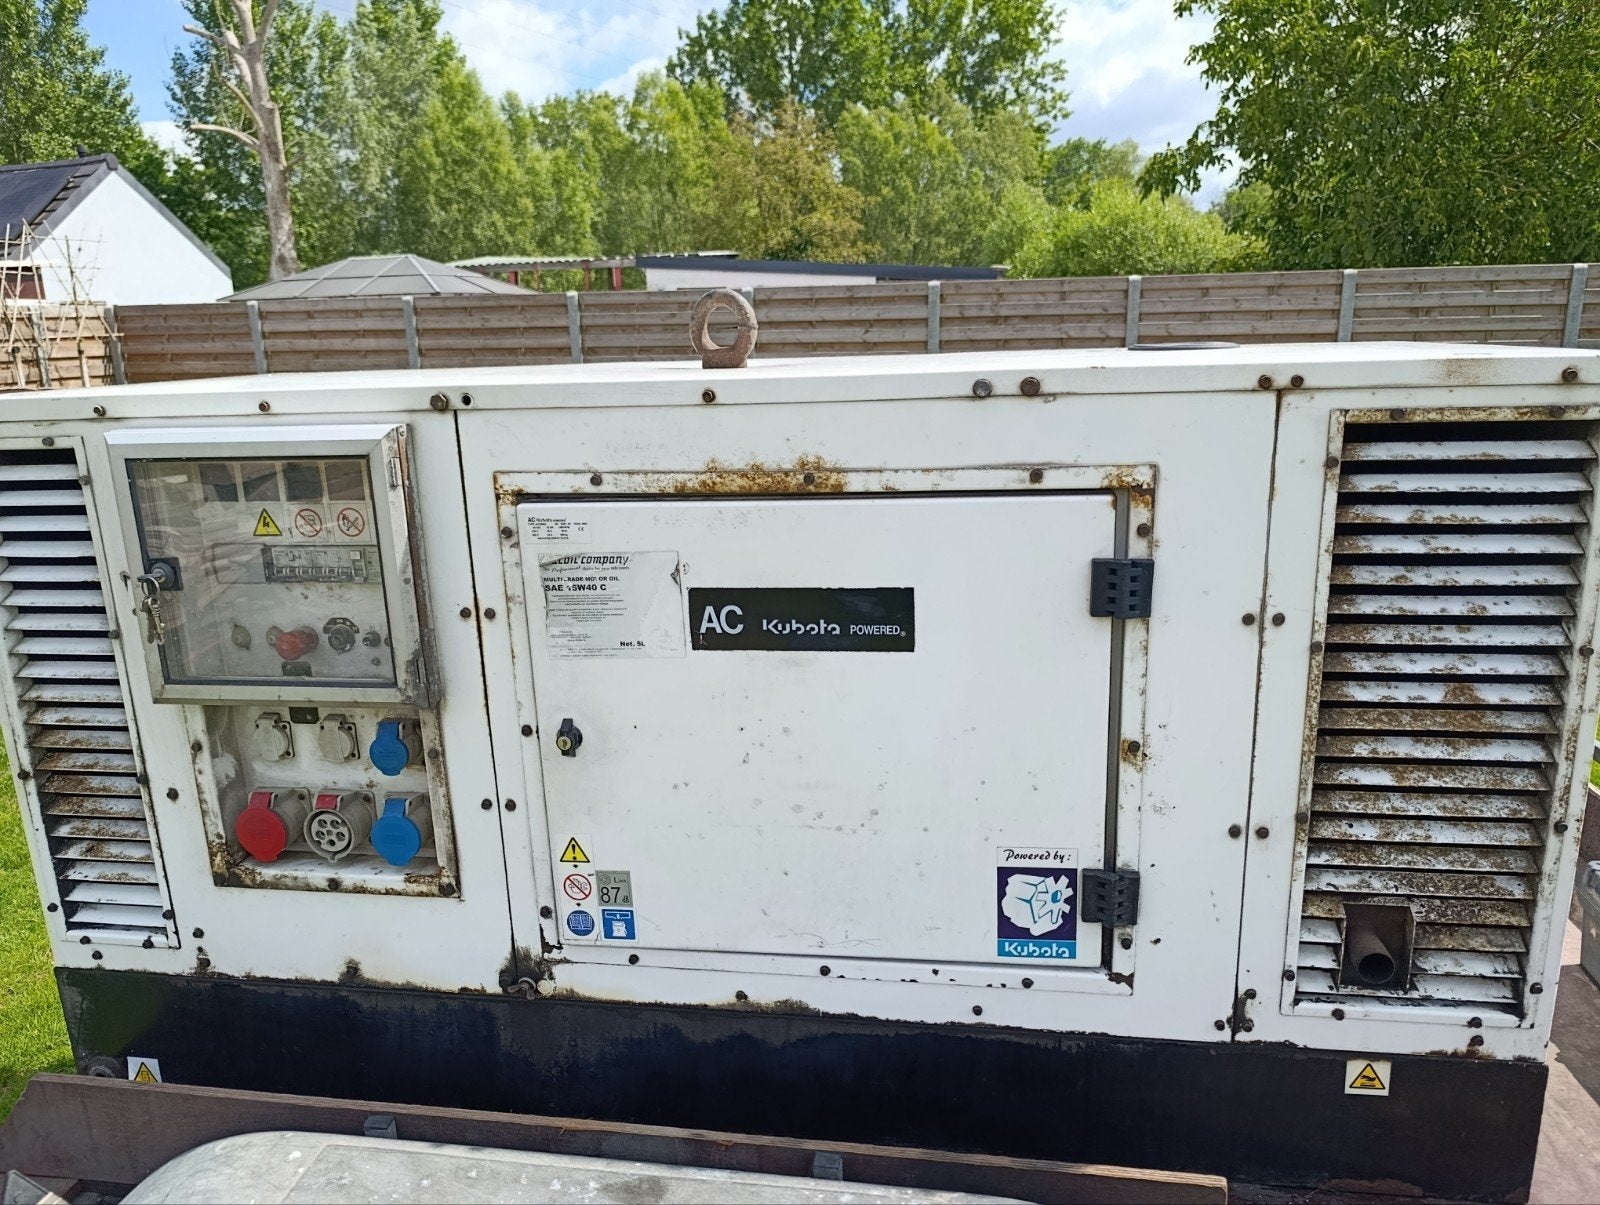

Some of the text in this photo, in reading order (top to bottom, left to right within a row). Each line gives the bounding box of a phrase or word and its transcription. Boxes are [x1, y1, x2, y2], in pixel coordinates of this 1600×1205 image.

[581, 556, 629, 567] company
[545, 584, 564, 592] SAE
[700, 605, 744, 635] AC
[762, 618, 841, 635] Kubota
[1003, 848, 1051, 861] Powered
[600, 886, 621, 903] 87
[1004, 941, 1070, 958] Kubota
